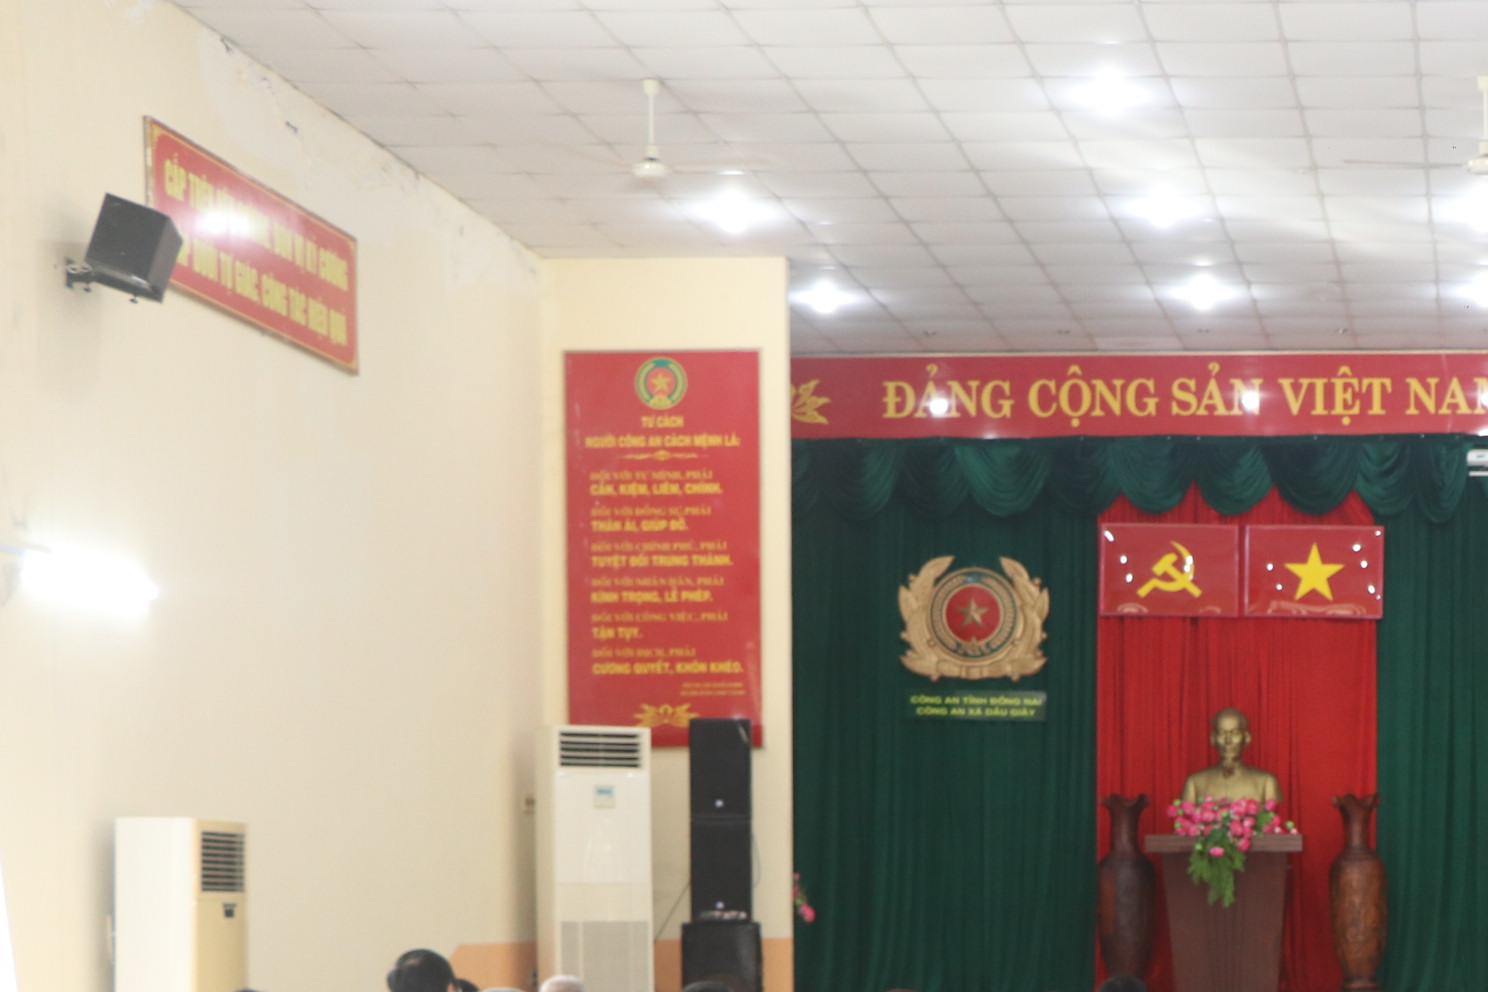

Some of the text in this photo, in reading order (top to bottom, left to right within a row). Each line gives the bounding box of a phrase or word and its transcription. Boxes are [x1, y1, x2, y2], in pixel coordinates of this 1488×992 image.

[881, 363, 1014, 419] ĐẢNG
[1028, 365, 1159, 427] CỘNG
[1171, 361, 1260, 417] SẢN
[1279, 364, 1393, 425] VIỆT
